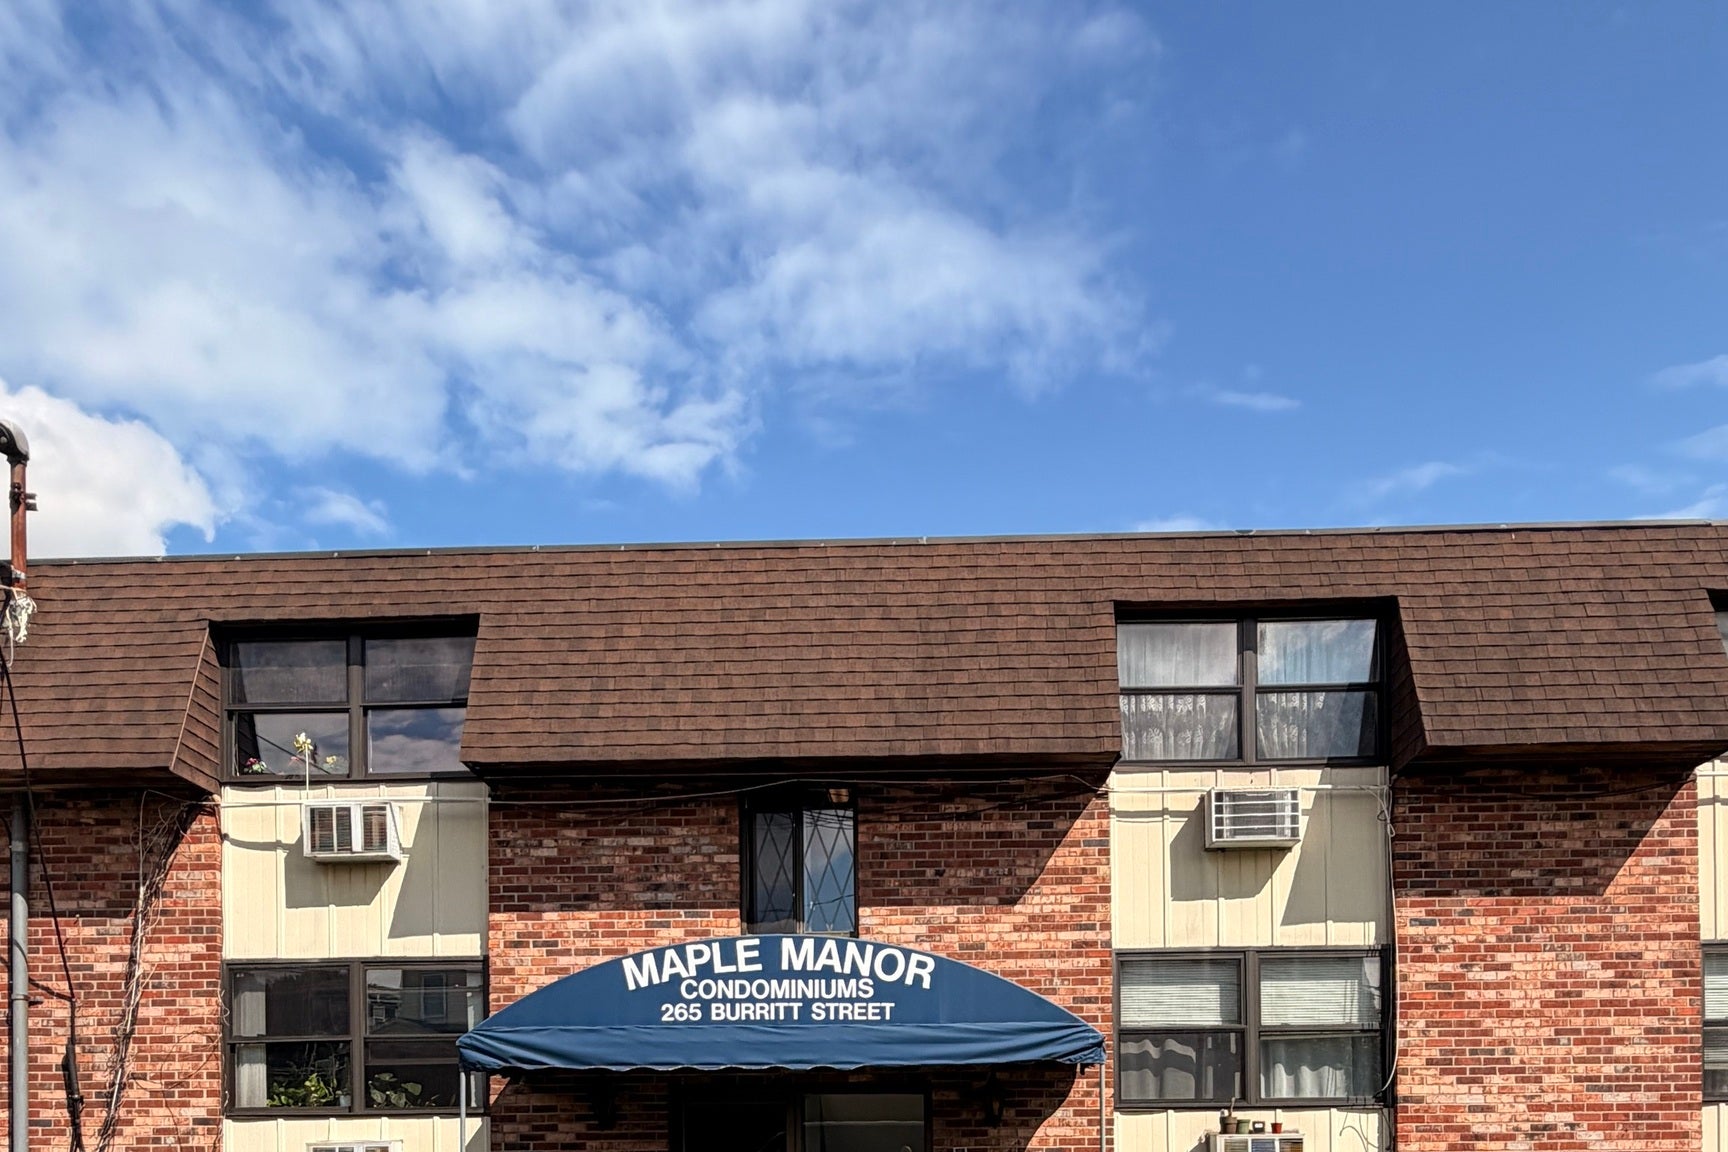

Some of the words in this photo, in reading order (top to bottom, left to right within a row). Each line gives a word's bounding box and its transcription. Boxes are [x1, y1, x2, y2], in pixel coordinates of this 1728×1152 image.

[622, 938, 763, 990] MAPLE
[781, 937, 935, 989] MANOR
[680, 978, 874, 1000] CONDOMINIUMS
[660, 1003, 702, 1021] 265
[711, 1002, 803, 1021] BURRITT
[811, 1002, 895, 1021] STREET
